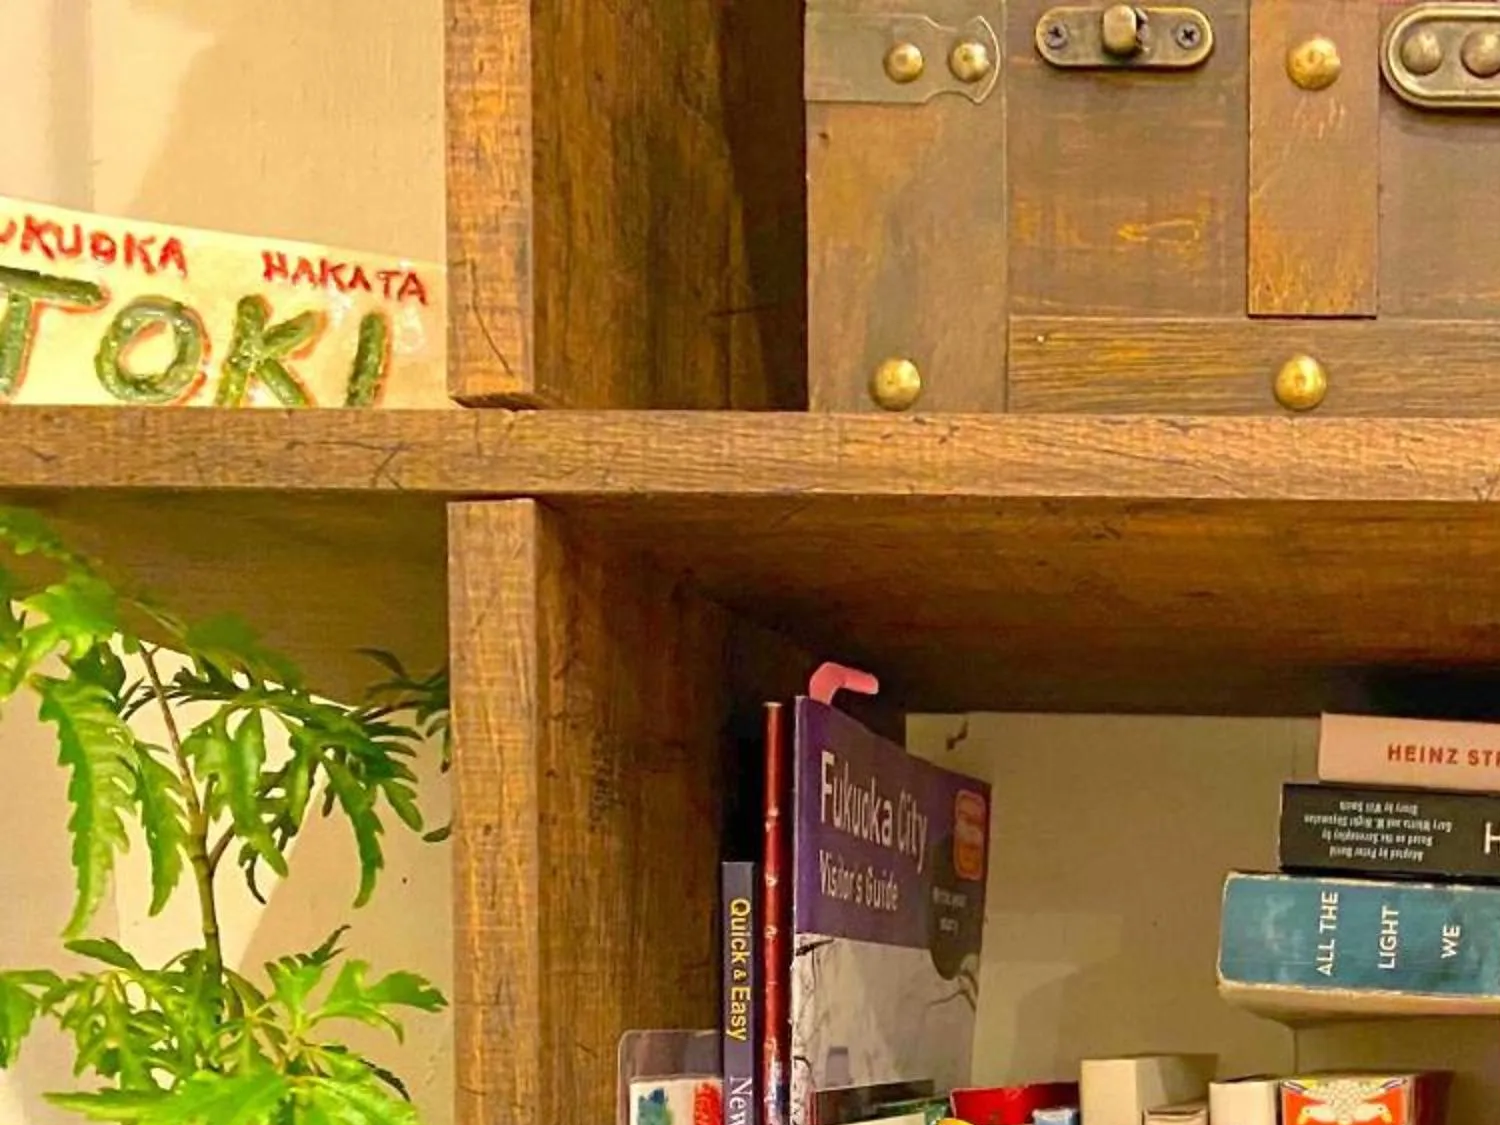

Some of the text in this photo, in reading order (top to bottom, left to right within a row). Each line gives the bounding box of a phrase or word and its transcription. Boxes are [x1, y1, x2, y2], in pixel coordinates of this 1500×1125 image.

[261, 250, 428, 305] HAKATA
[1386, 744, 1458, 766] HEINZ
[820, 750, 894, 847] Fukuoka
[897, 790, 929, 875] City
[865, 865, 899, 912] Guide
[729, 898, 751, 962] Quick
[1316, 891, 1340, 977] ALL THE
[1377, 905, 1399, 970] LIGHT
[1440, 924, 1461, 959] WE
[732, 969, 748, 981] &
[725, 986, 751, 1042] Easy
